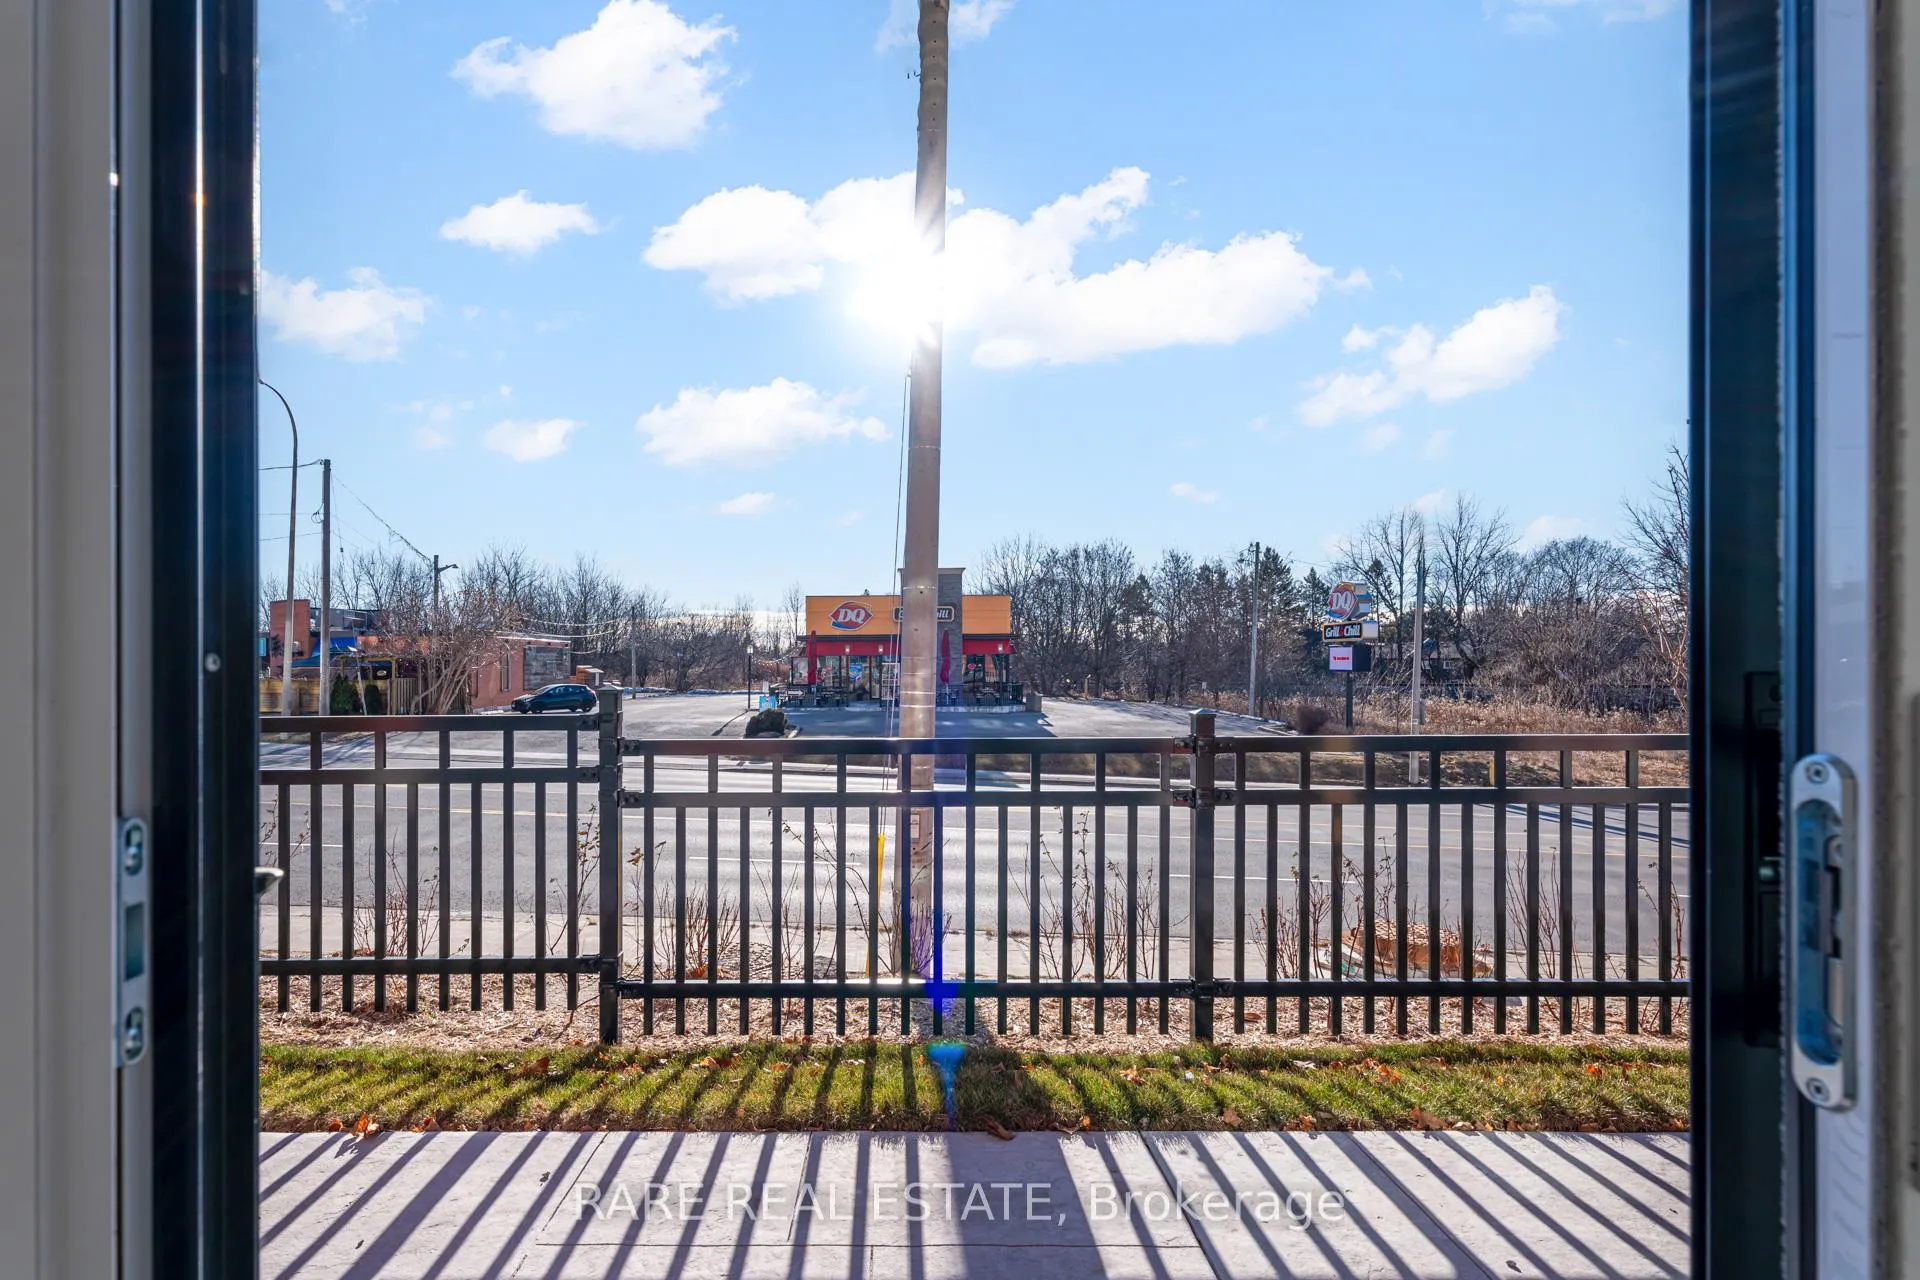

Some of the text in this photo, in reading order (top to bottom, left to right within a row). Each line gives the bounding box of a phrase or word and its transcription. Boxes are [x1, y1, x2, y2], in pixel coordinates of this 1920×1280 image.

[1332, 590, 1352, 613] DQ
[839, 608, 866, 624] DQ
[1326, 626, 1340, 638] Grill
[1344, 624, 1360, 636] Chill
